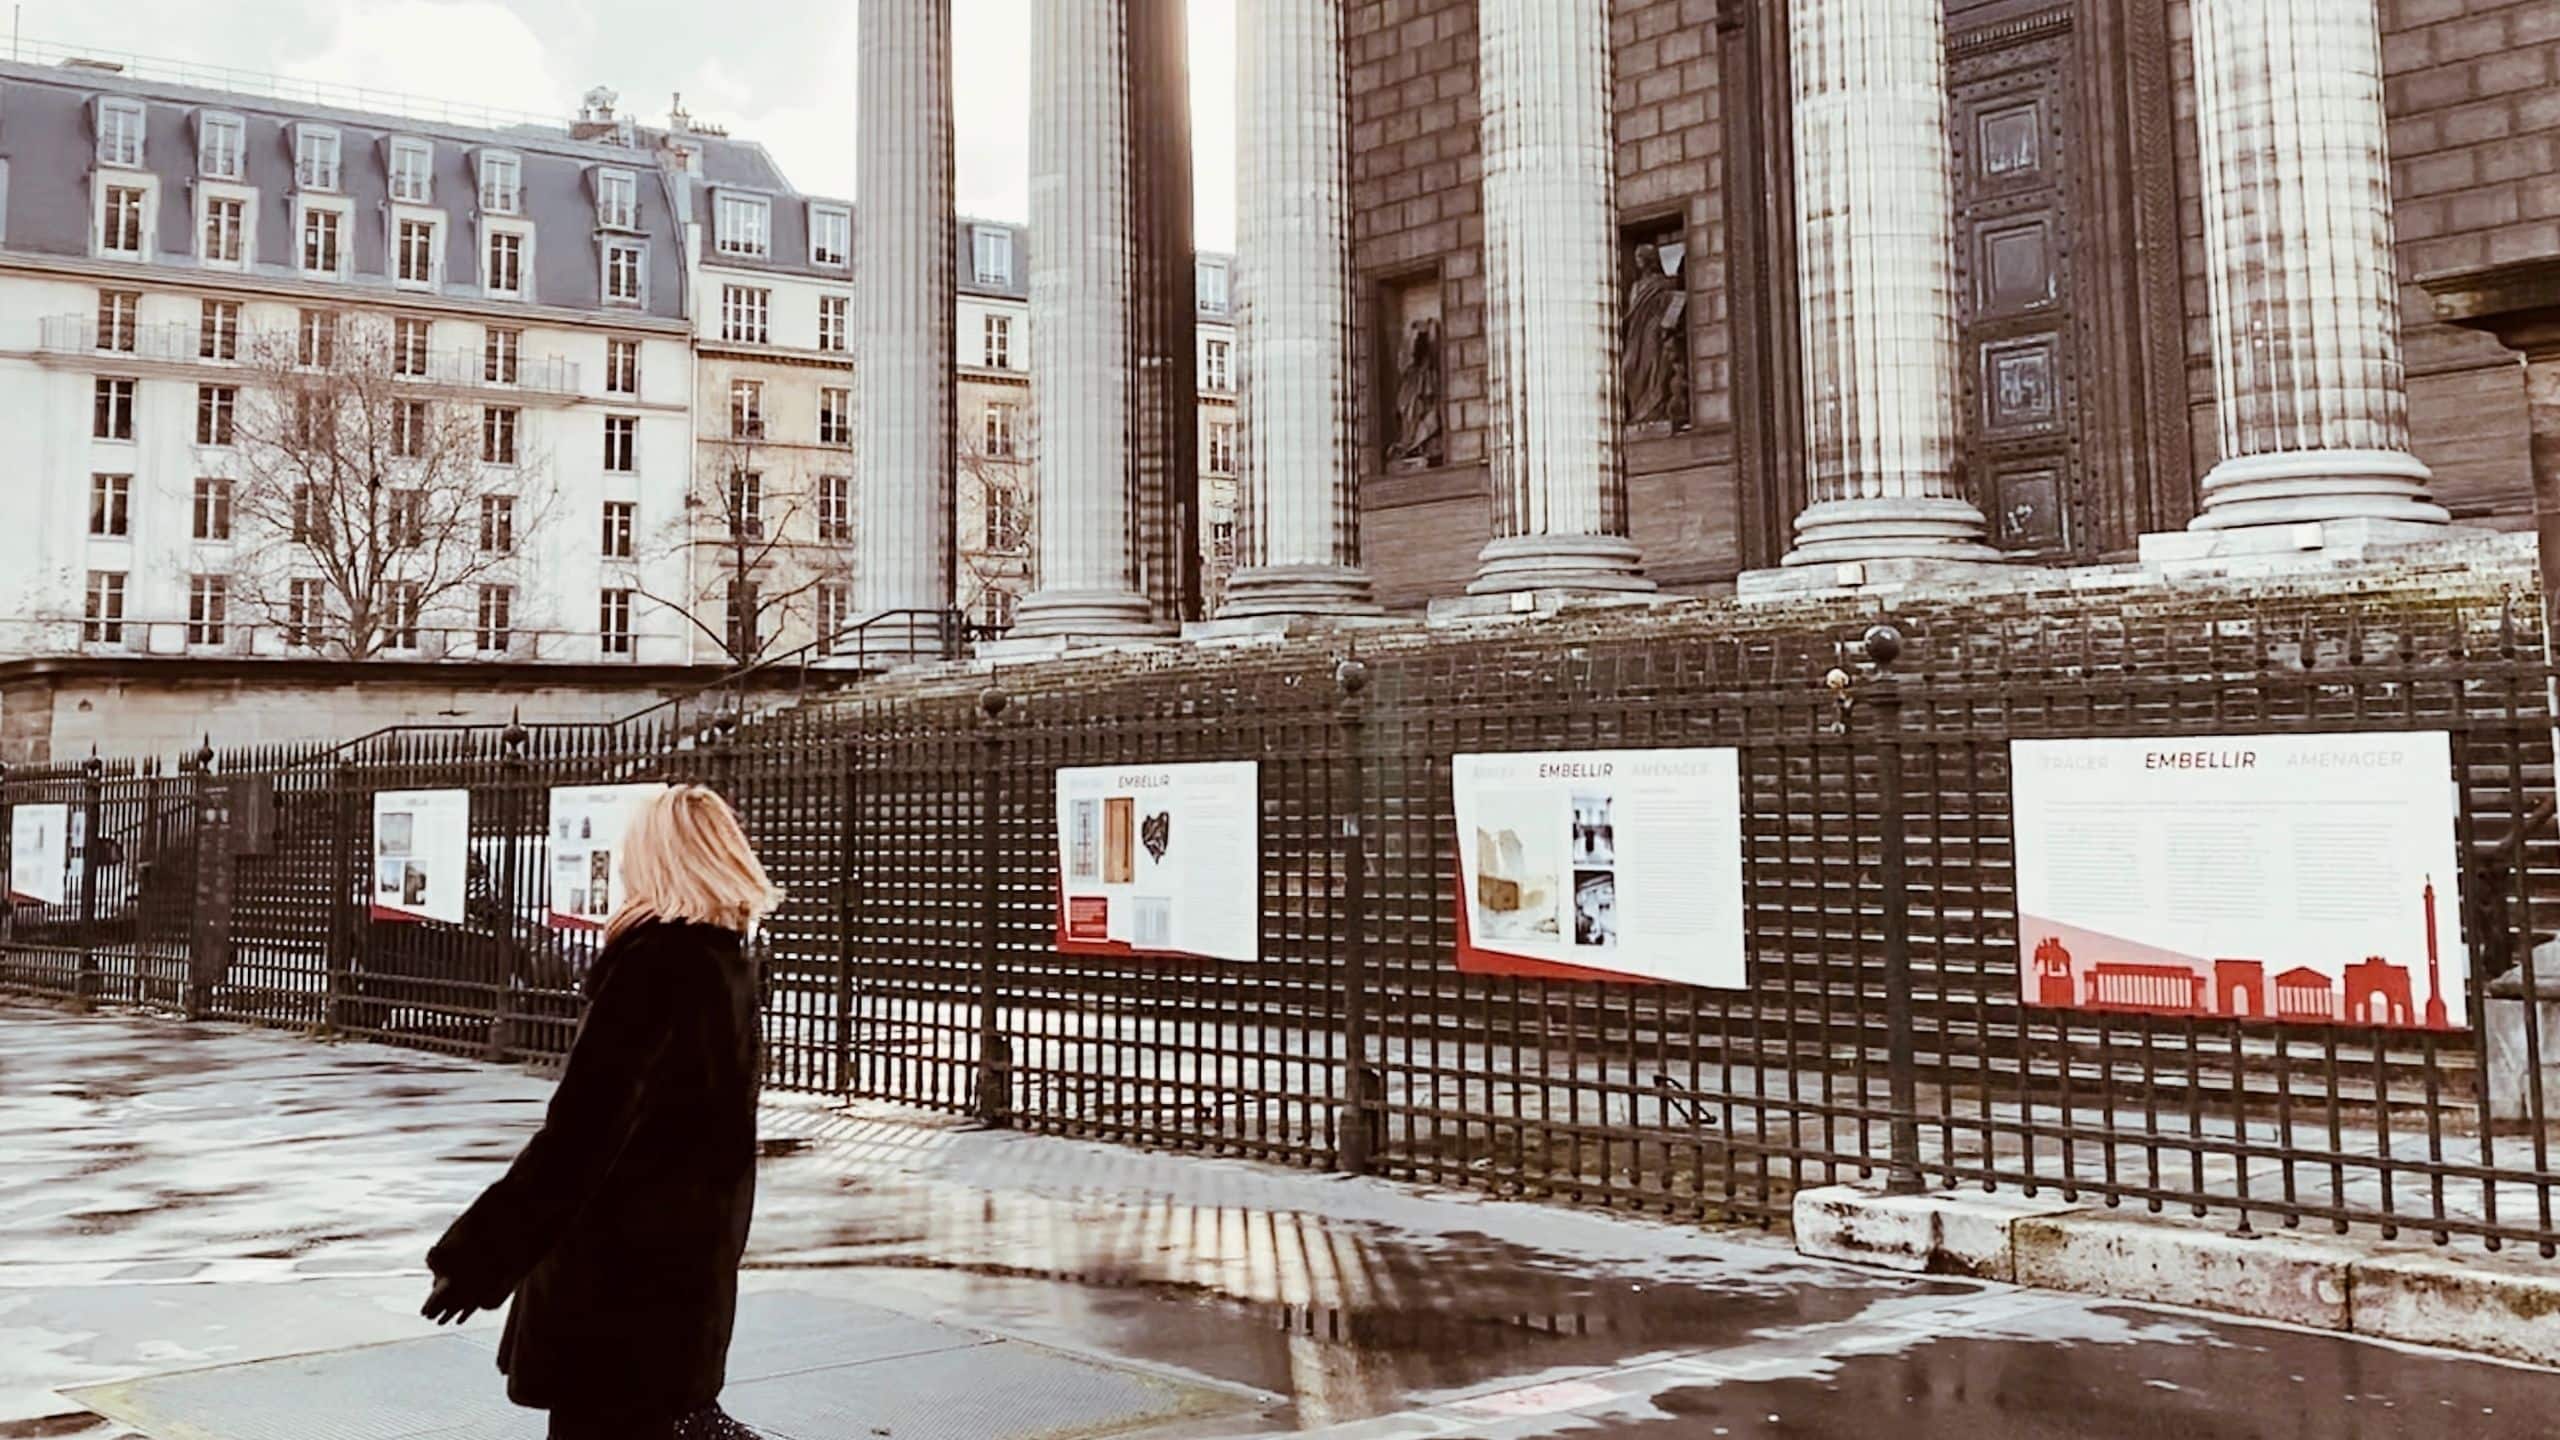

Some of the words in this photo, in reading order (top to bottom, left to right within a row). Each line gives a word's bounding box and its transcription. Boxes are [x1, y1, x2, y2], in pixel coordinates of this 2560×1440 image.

[2145, 751, 2257, 769] EMBELLIR
[1538, 762, 1614, 778] EMBELLIR
[1117, 774, 1171, 789] EMBELLIR
